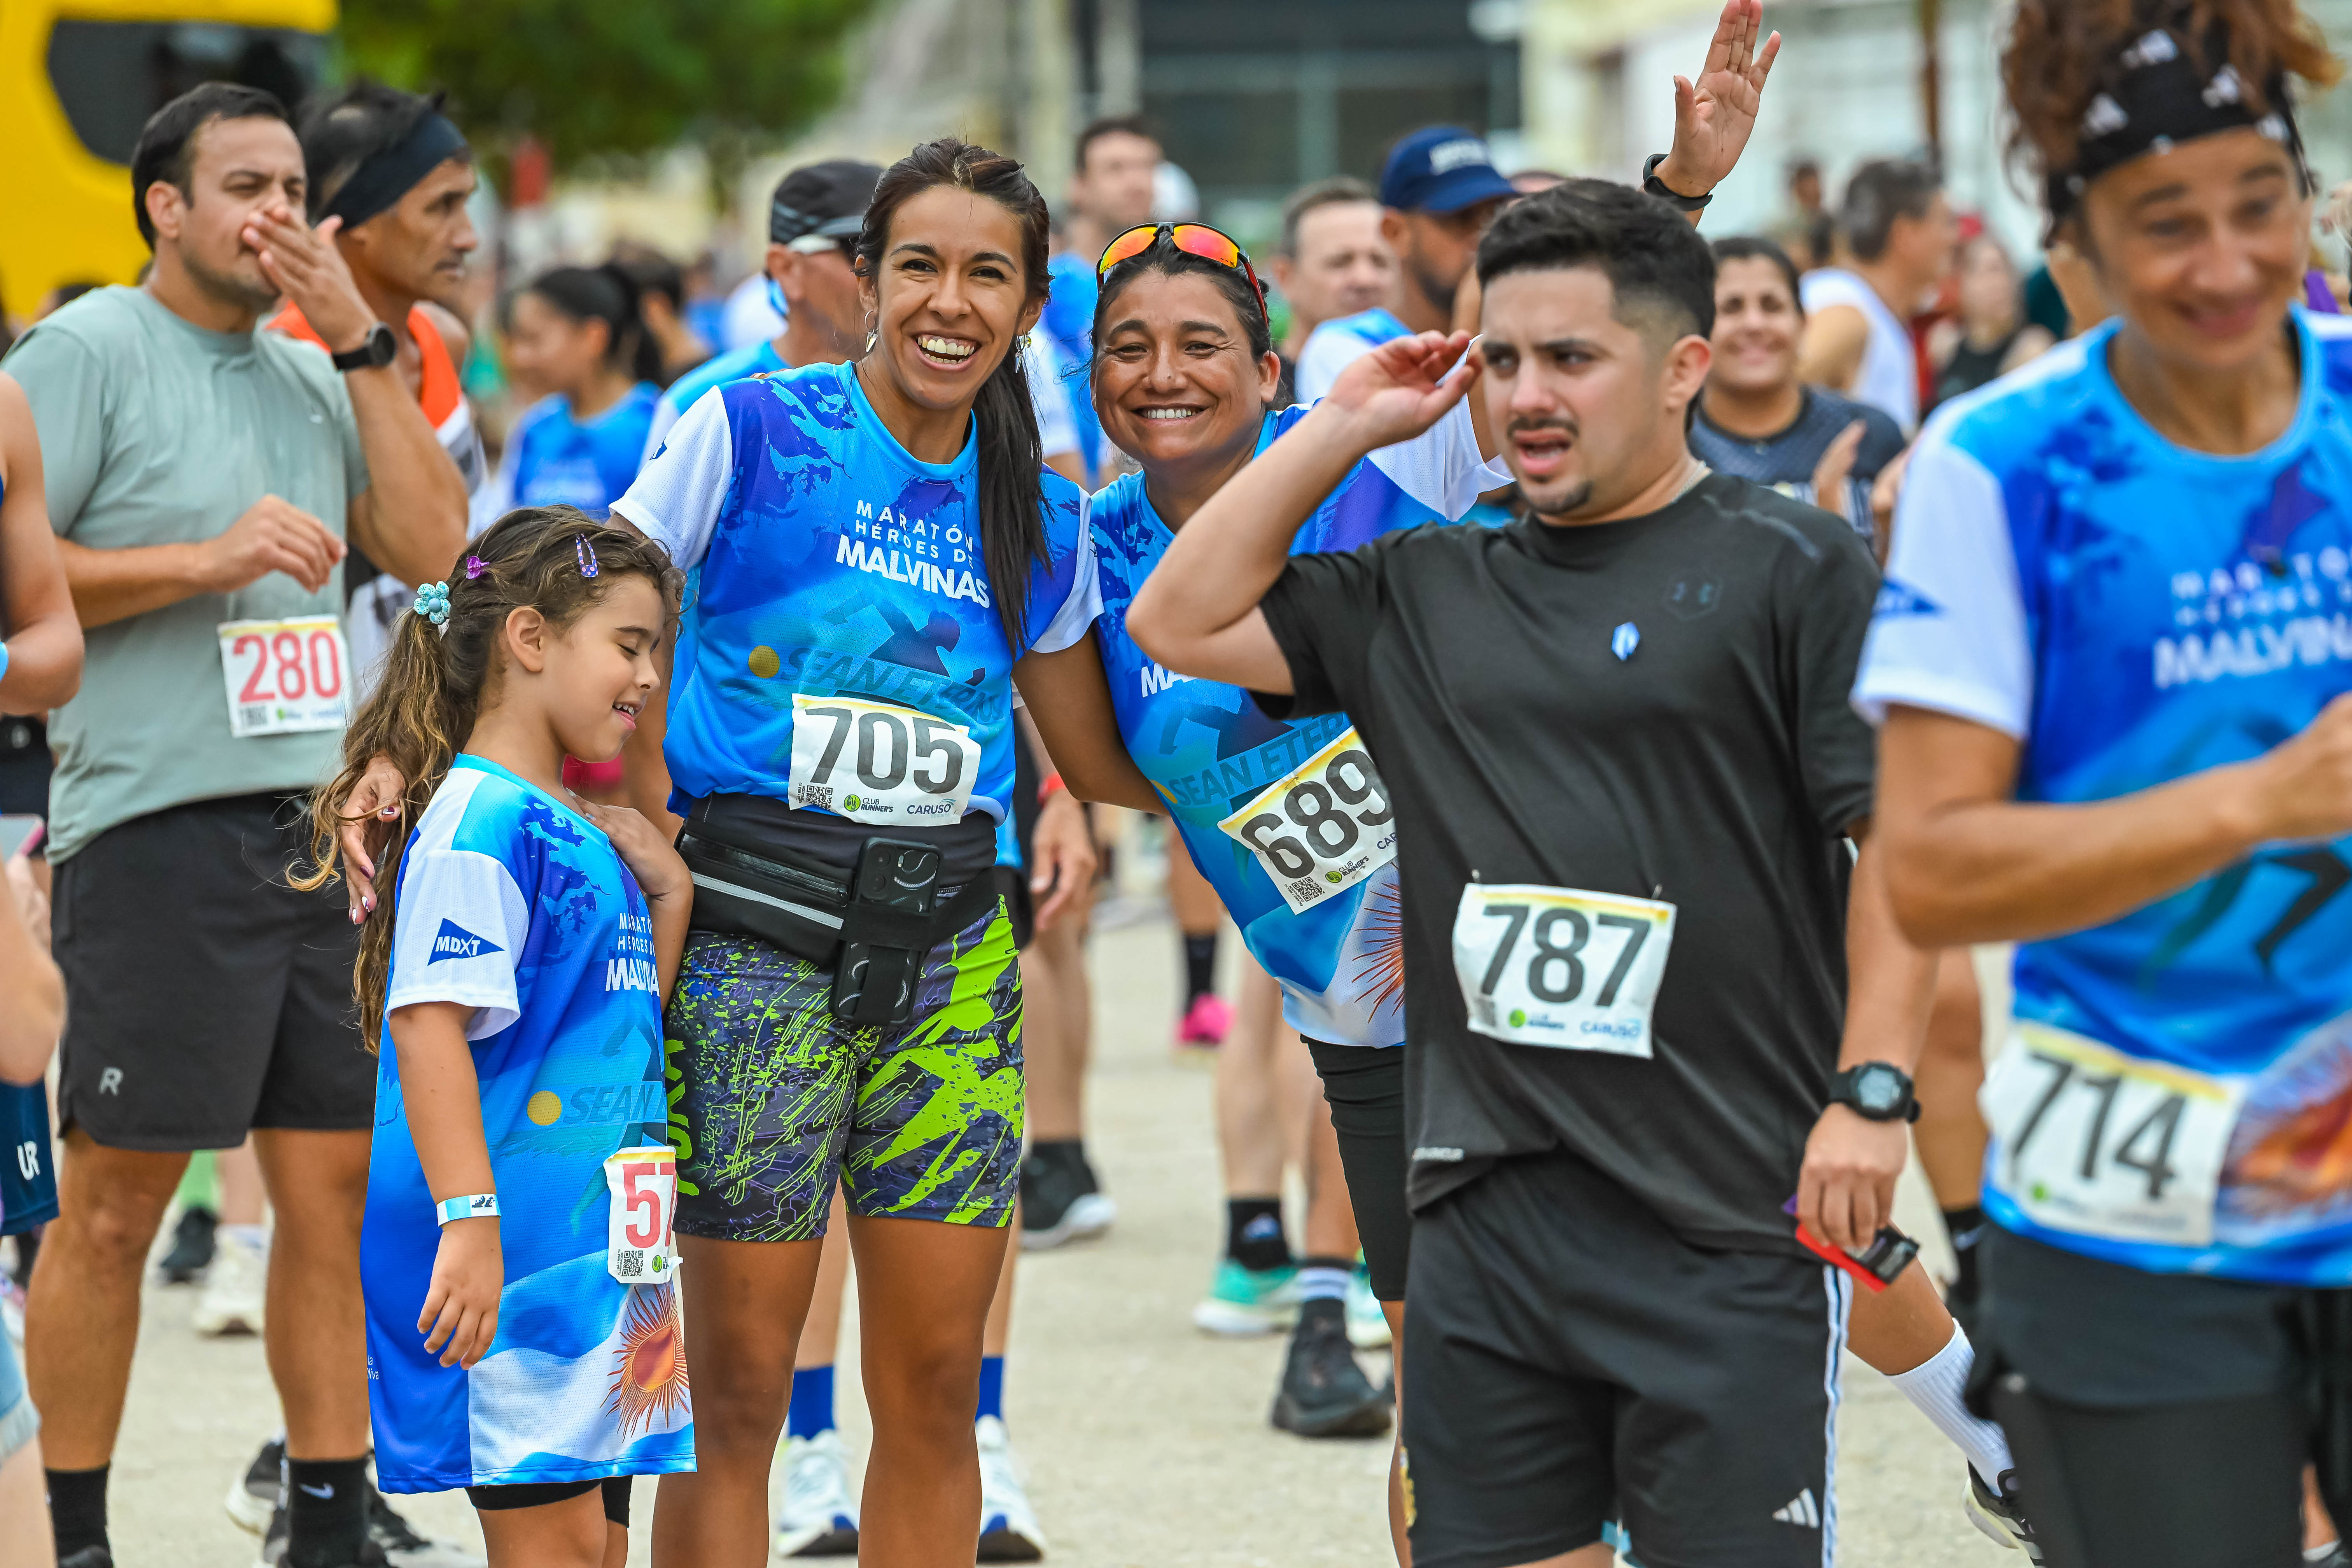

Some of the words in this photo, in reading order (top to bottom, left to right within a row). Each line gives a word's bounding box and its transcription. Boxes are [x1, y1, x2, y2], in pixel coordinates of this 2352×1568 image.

[855, 519, 939, 559] HÉROES
[954, 548, 974, 570] DE
[856, 499, 973, 552] MARATÓN
[836, 534, 990, 609] MALVINAS
[232, 630, 342, 704] 280
[779, 648, 895, 692] SEAN
[805, 707, 964, 794] 705
[1169, 753, 1254, 807] SEAN
[1259, 712, 1344, 779] ETER
[860, 803, 894, 813] RUNNER'S
[906, 803, 952, 815] CARUSO
[1241, 749, 1394, 879] 689
[1377, 831, 1397, 850] CAR
[1338, 860, 1354, 873] CLUB
[1341, 856, 1370, 876] RUNNER'S
[618, 932, 648, 954] HÉROES
[619, 912, 652, 935] MARATÓ
[435, 934, 480, 957] MDXT
[1482, 904, 1652, 1008] 787
[606, 957, 660, 997] MALVINA
[563, 1084, 655, 1124] SEAN
[2010, 1050, 2186, 1201] 714
